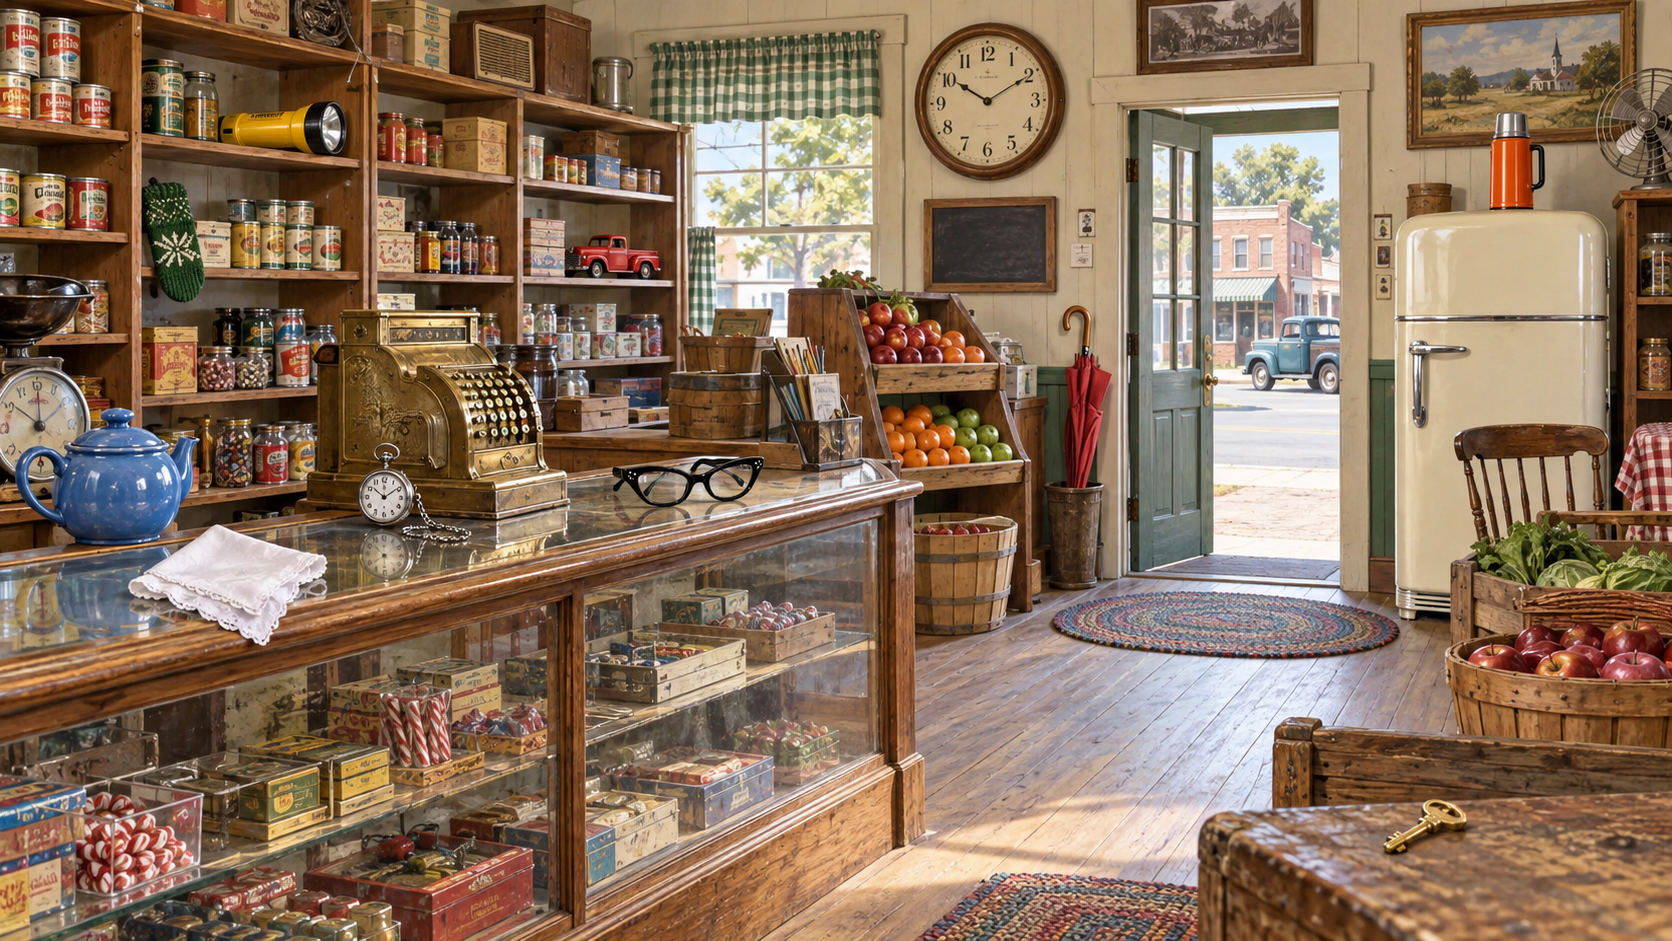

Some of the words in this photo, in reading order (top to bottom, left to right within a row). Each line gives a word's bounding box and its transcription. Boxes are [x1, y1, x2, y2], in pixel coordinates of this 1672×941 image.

[960, 54, 971, 69] 11
[981, 46, 995, 62] 12
[1009, 52, 1014, 67] 1
[943, 72, 956, 87] 10
[1024, 68, 1034, 83] 2
[936, 96, 946, 111] 9
[1030, 92, 1040, 108] 3
[943, 119, 953, 135] 8
[1022, 117, 1033, 132] 4
[960, 136, 970, 151] 7
[983, 142, 993, 157] 6
[1007, 135, 1016, 150] 5
